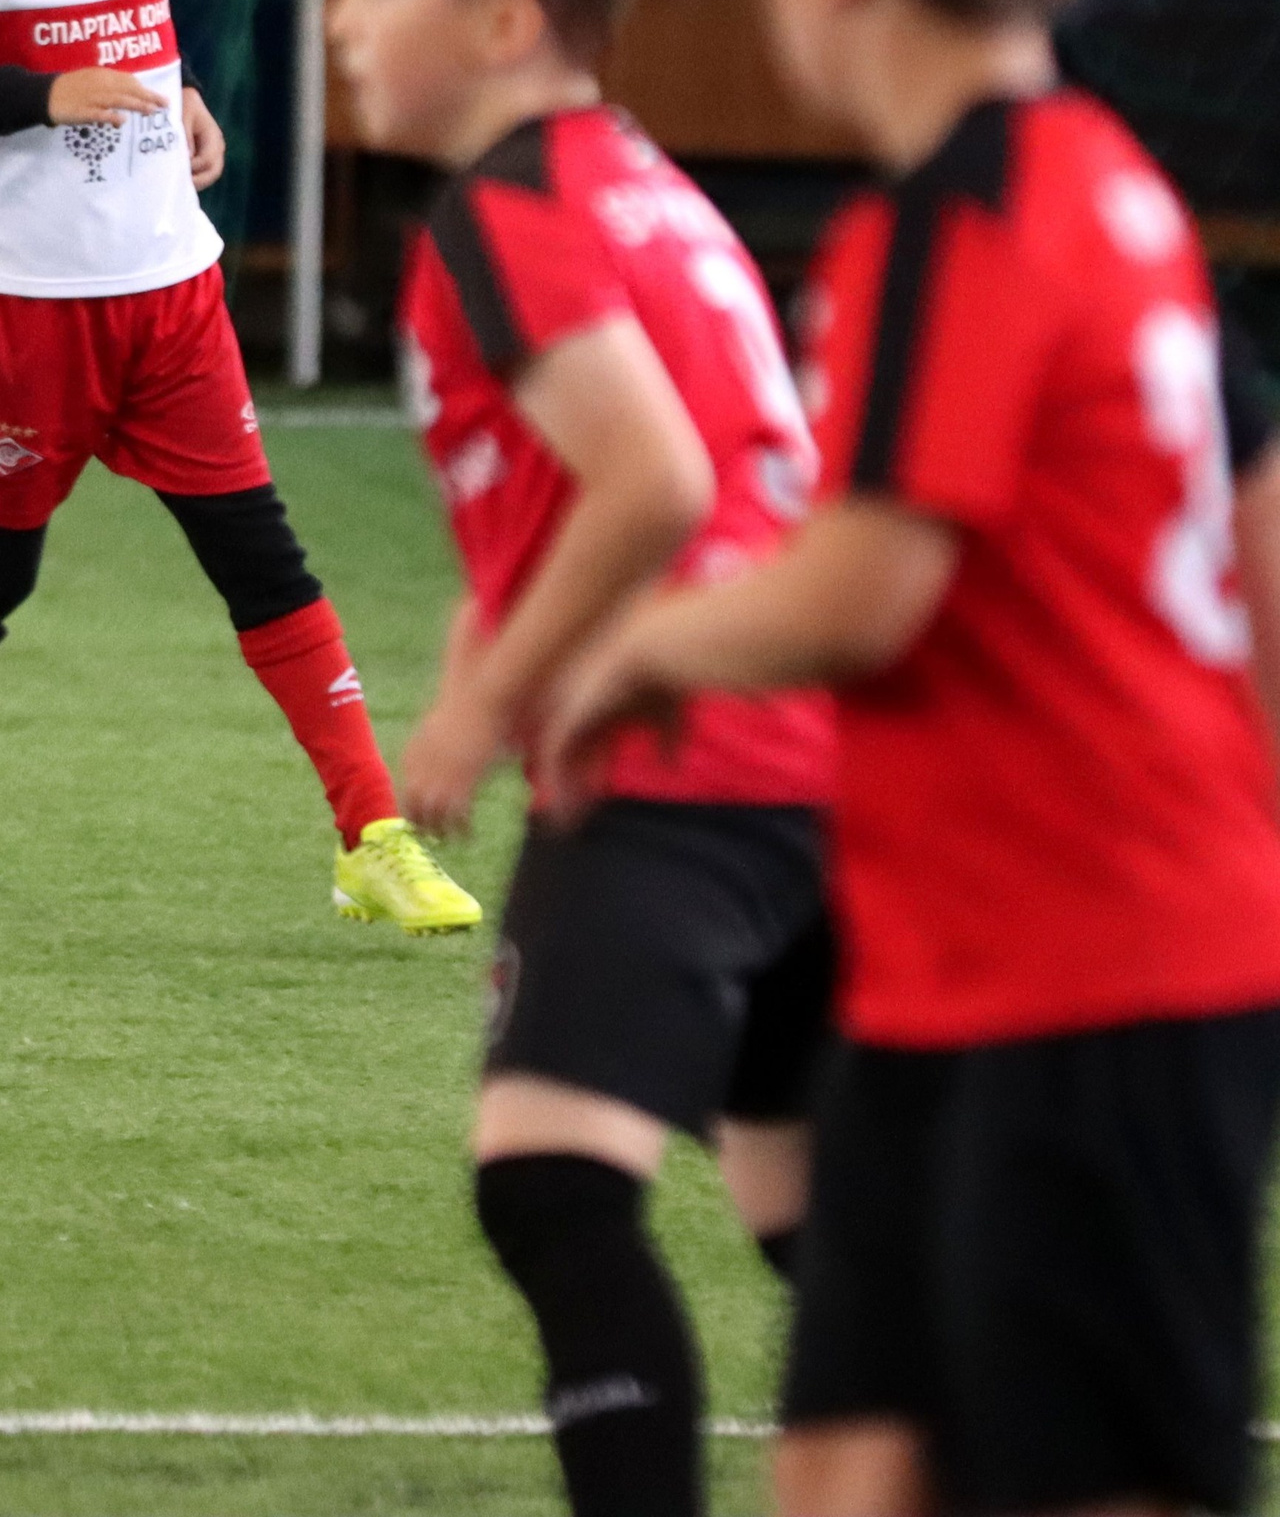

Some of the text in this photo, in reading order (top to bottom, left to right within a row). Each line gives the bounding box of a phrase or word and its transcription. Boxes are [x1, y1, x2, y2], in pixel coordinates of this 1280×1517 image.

[33, 8, 138, 47] СПАРТАК
[97, 30, 163, 66] ДУБНА
[140, 131, 180, 155] ФАР
